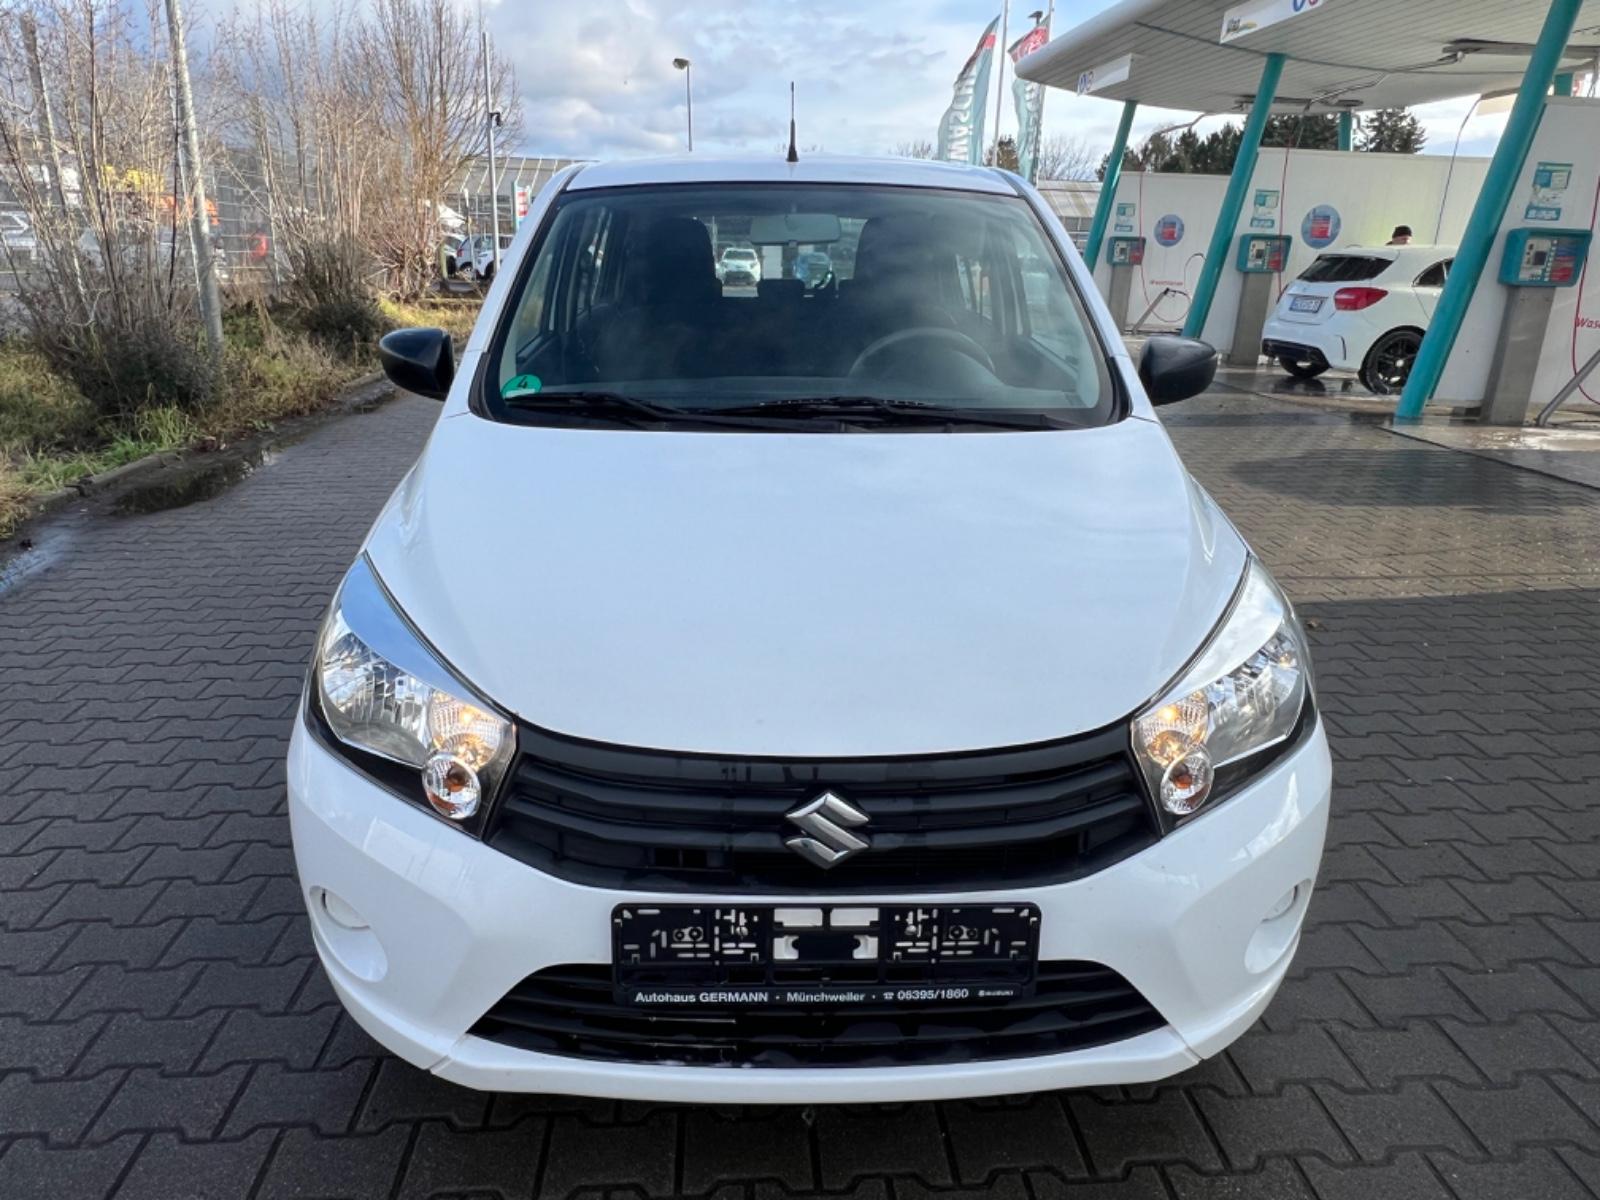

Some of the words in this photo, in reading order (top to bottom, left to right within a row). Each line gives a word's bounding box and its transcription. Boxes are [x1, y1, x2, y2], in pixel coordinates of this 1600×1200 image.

[517, 375, 529, 389] 4
[635, 991, 696, 1003] Autohaus
[699, 991, 768, 1003] GERMANN
[786, 990, 865, 1003] Münchweiler
